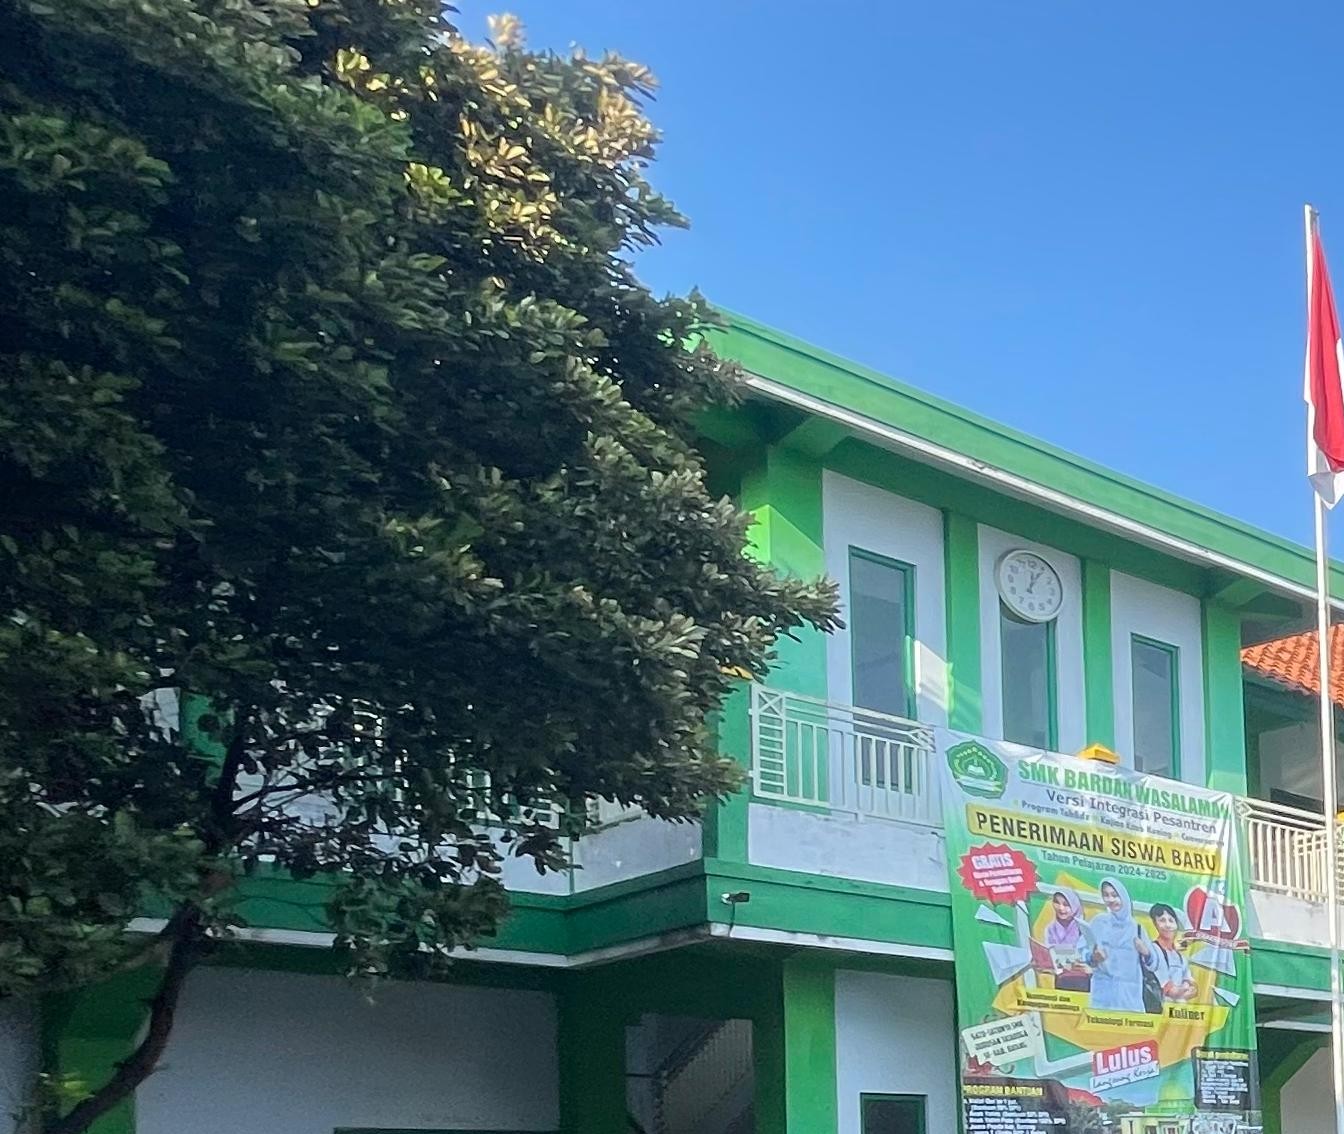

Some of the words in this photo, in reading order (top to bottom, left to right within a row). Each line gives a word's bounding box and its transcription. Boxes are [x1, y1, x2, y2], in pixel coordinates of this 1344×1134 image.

[1018, 760, 1060, 786] SMK
[1064, 768, 1132, 799] BARDAN
[1046, 789, 1085, 807] Versi
[1089, 797, 1149, 821] Integrasi
[1153, 811, 1217, 834] Pesantren
[976, 811, 1104, 853] PENERIMAAN
[1111, 837, 1166, 864] SISWA
[1172, 849, 1216, 872] BARU
[1041, 850, 1070, 865] Tahun
[1072, 855, 1116, 873] Pelajaran
[1118, 864, 1167, 881] 2024-2025
[1168, 1007, 1205, 1020] Kuliner
[1096, 1046, 1152, 1075] Lulus
